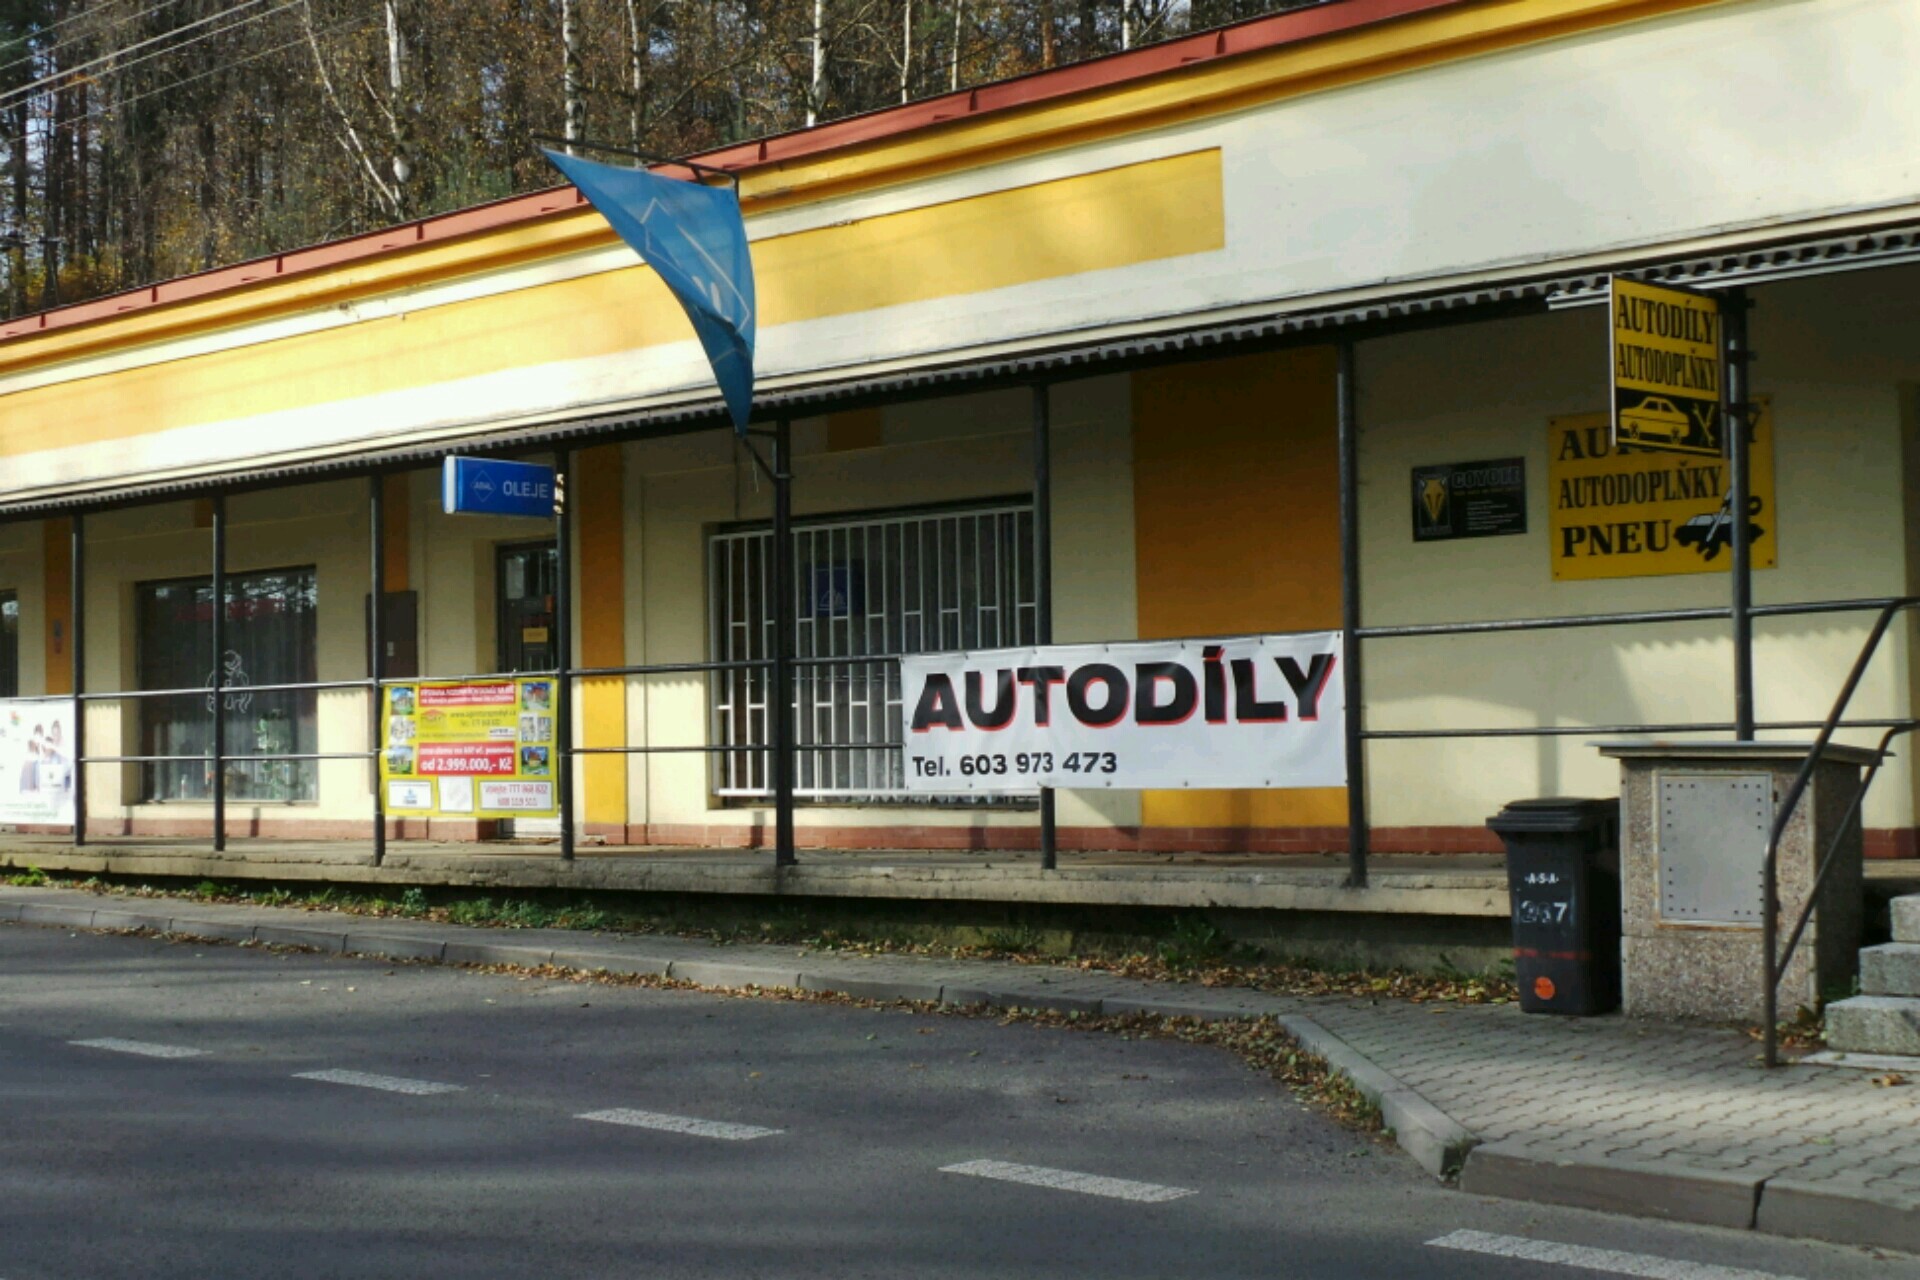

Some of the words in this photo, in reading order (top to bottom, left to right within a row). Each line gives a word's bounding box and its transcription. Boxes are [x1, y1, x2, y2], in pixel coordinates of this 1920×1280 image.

[1616, 294, 1716, 344] AUTODÍLY
[1617, 343, 1717, 392] AUTODOPLŇKY
[503, 480, 548, 498] OLEJE
[1558, 460, 1723, 510] AUTODOPLŇKY
[1561, 519, 1672, 558] PNEU
[910, 645, 1338, 732] AUTODÍLY
[421, 757, 435, 771] od
[499, 755, 513, 771] Kč
[912, 755, 951, 777] Tel.
[959, 754, 1008, 776] 603
[1016, 752, 1054, 775] 973
[1062, 752, 1118, 774] 473
